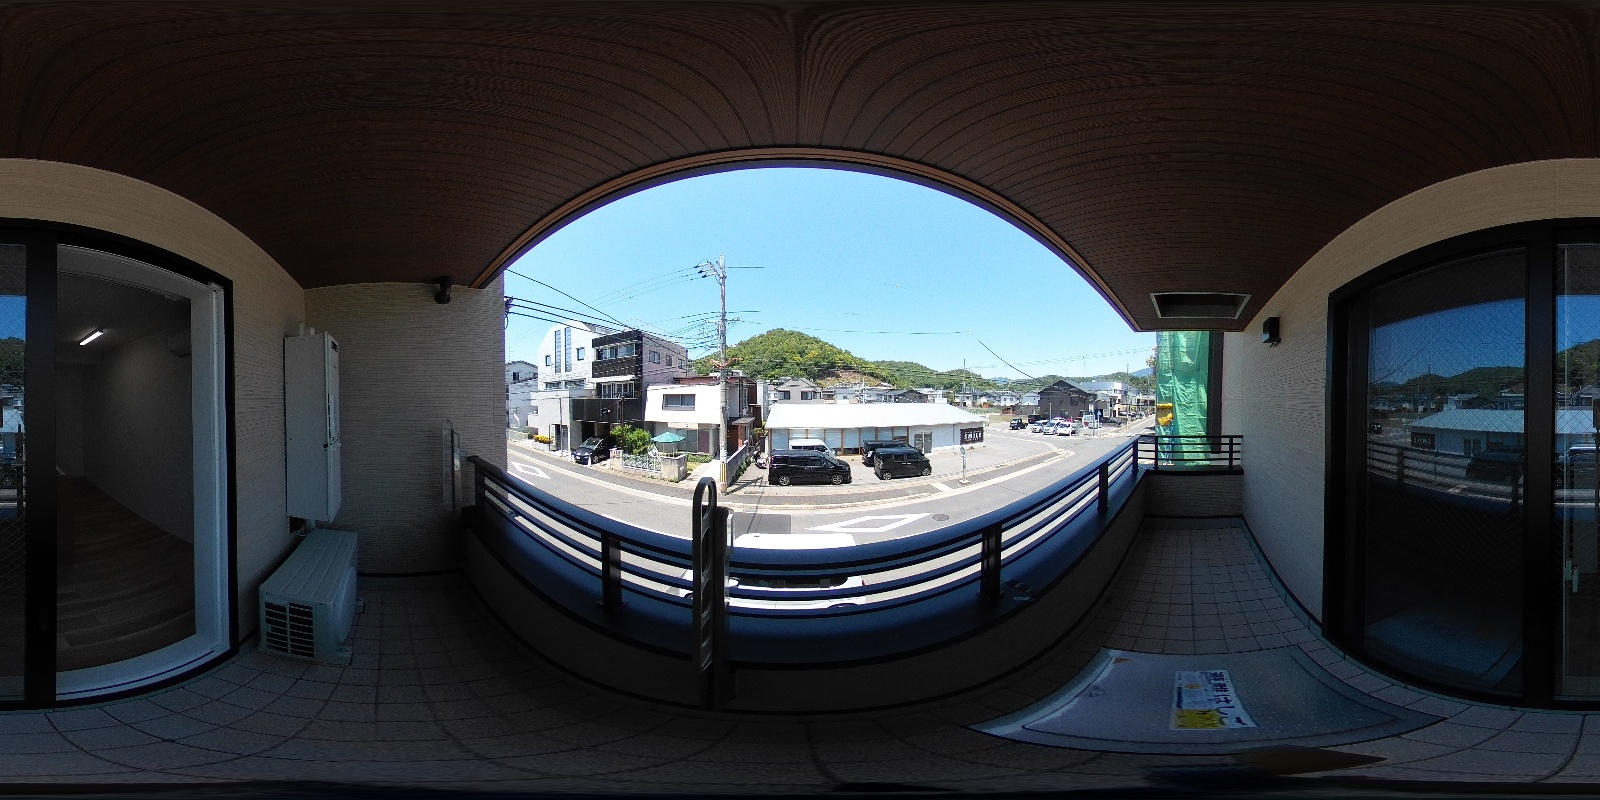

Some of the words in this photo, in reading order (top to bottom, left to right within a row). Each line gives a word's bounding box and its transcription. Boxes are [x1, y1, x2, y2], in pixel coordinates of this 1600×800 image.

[1210, 671, 1247, 726] 避難はしご
